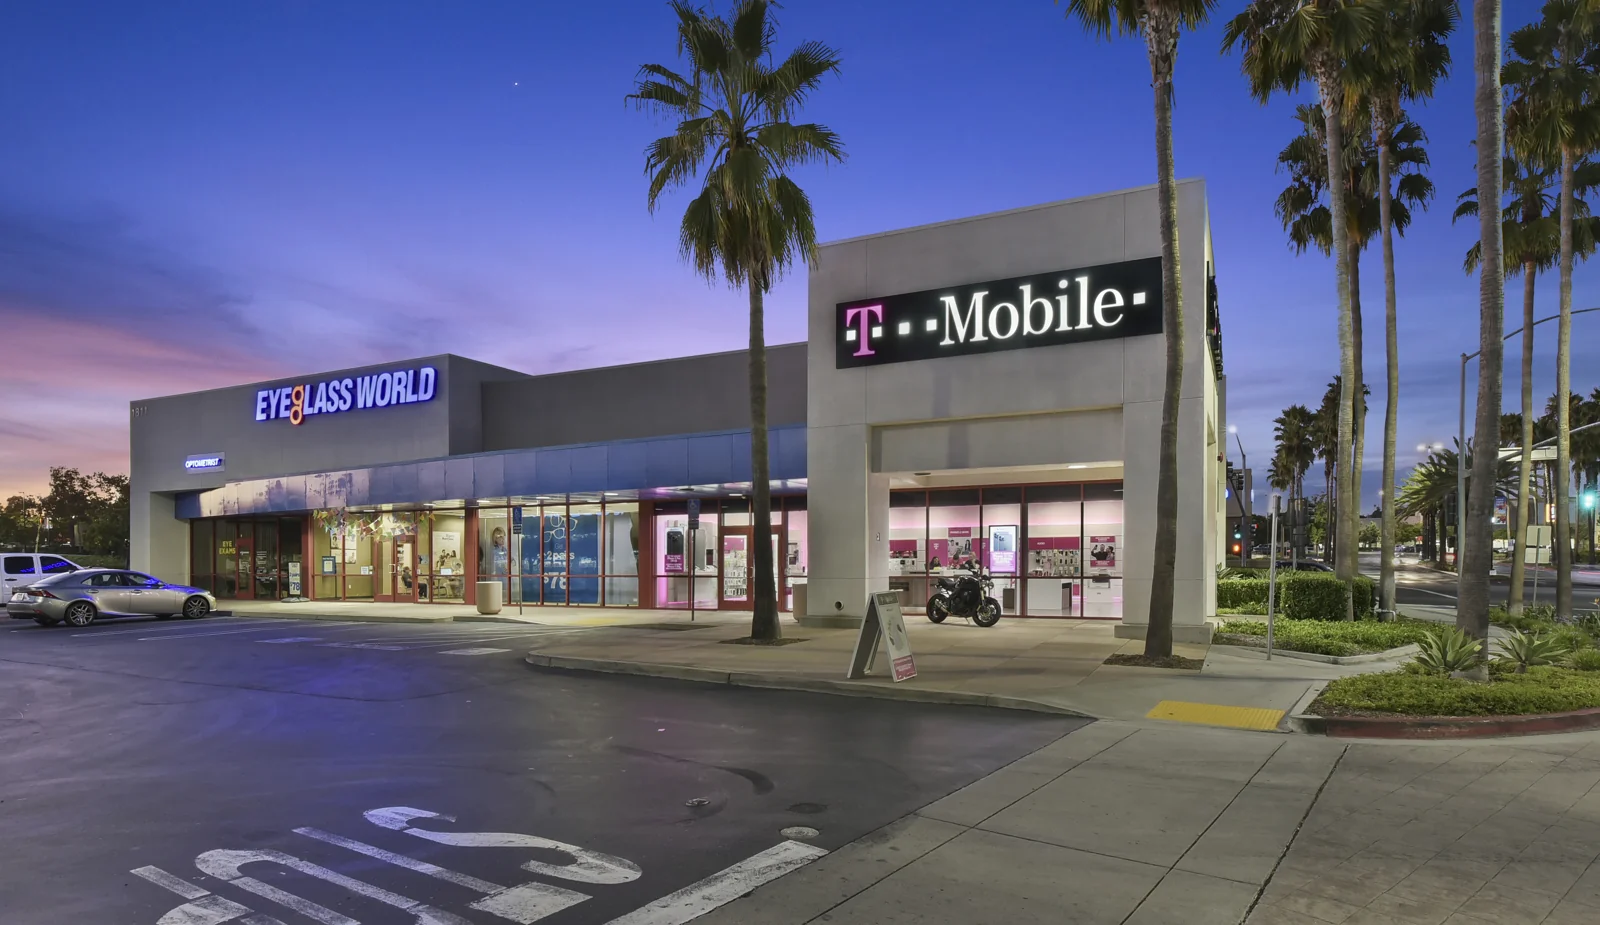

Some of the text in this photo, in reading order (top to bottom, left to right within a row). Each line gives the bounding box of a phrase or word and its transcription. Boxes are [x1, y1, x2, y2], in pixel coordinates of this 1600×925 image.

[356, 366, 435, 409] WORLD
[131, 405, 147, 418] 1811
[185, 458, 219, 468] OPTOMETRIST
[218, 547, 236, 555] EXAMS
[552, 550, 576, 563] pais
